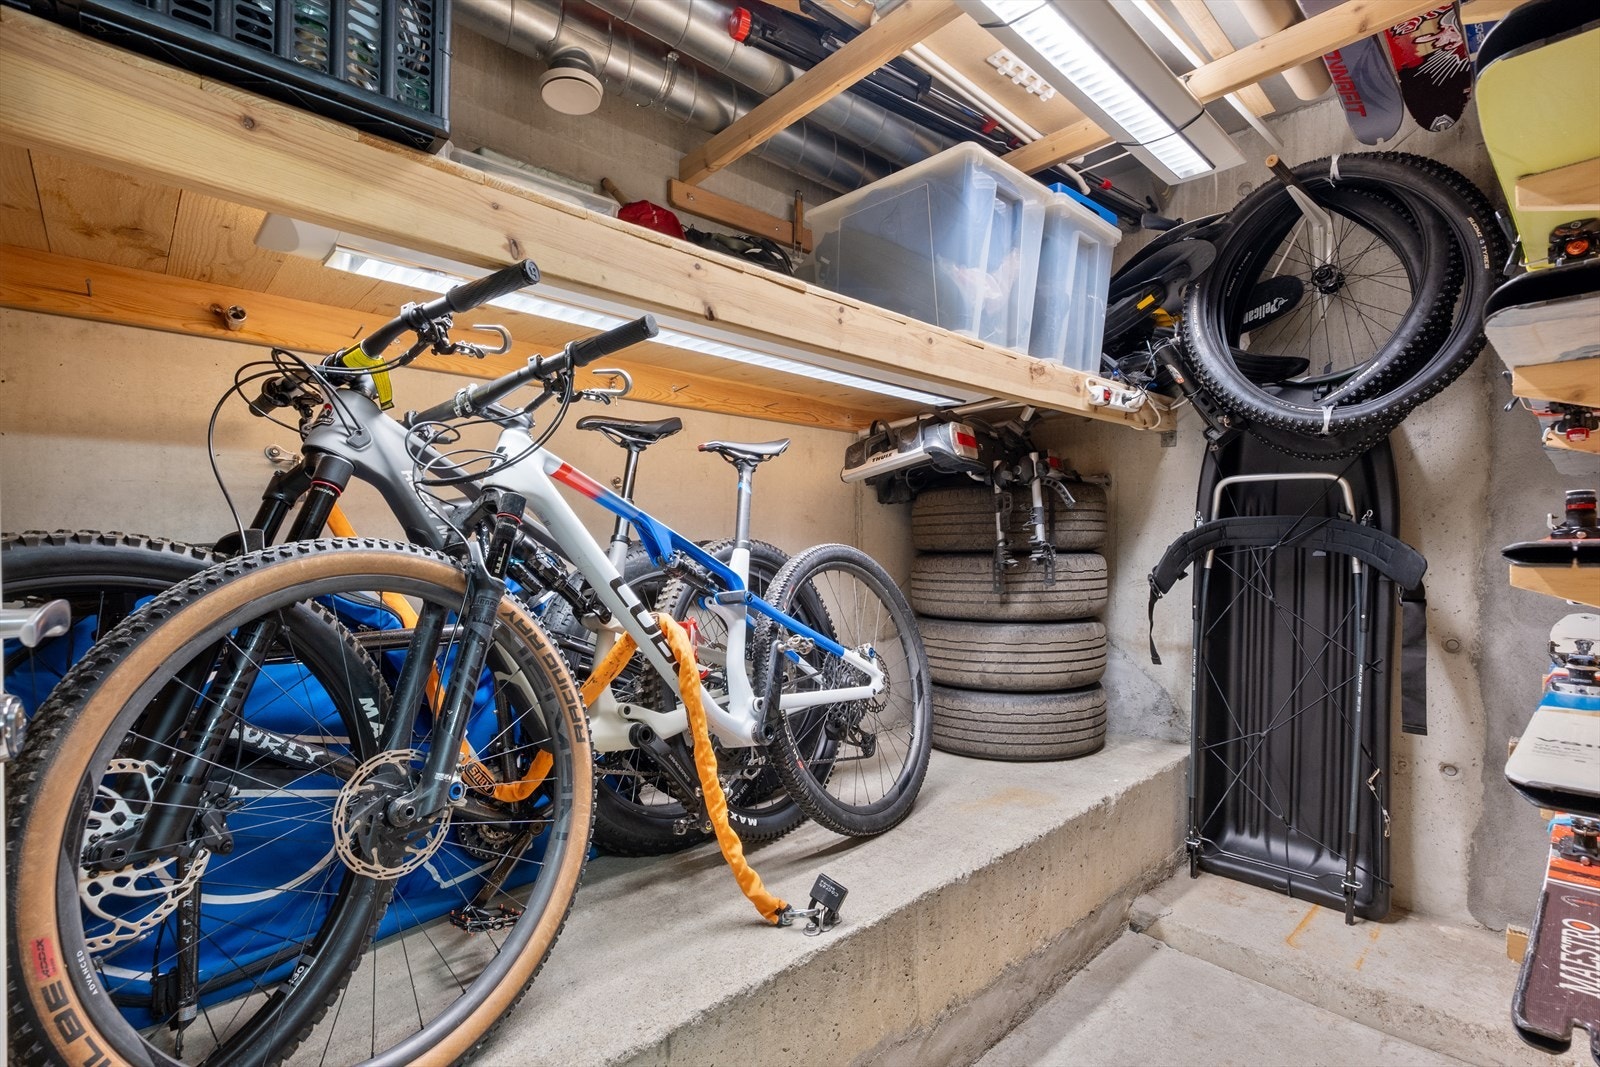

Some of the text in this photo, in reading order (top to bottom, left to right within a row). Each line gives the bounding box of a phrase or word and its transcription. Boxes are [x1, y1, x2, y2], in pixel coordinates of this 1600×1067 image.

[1243, 297, 1289, 324] Pelican
[871, 452, 893, 464] THULE
[501, 610, 546, 650] RAY
[542, 652, 587, 743] RACING
[182, 861, 194, 945] SRLY
[77, 949, 98, 996] ADVANCED
[1559, 918, 1600, 999] MAESTRO
